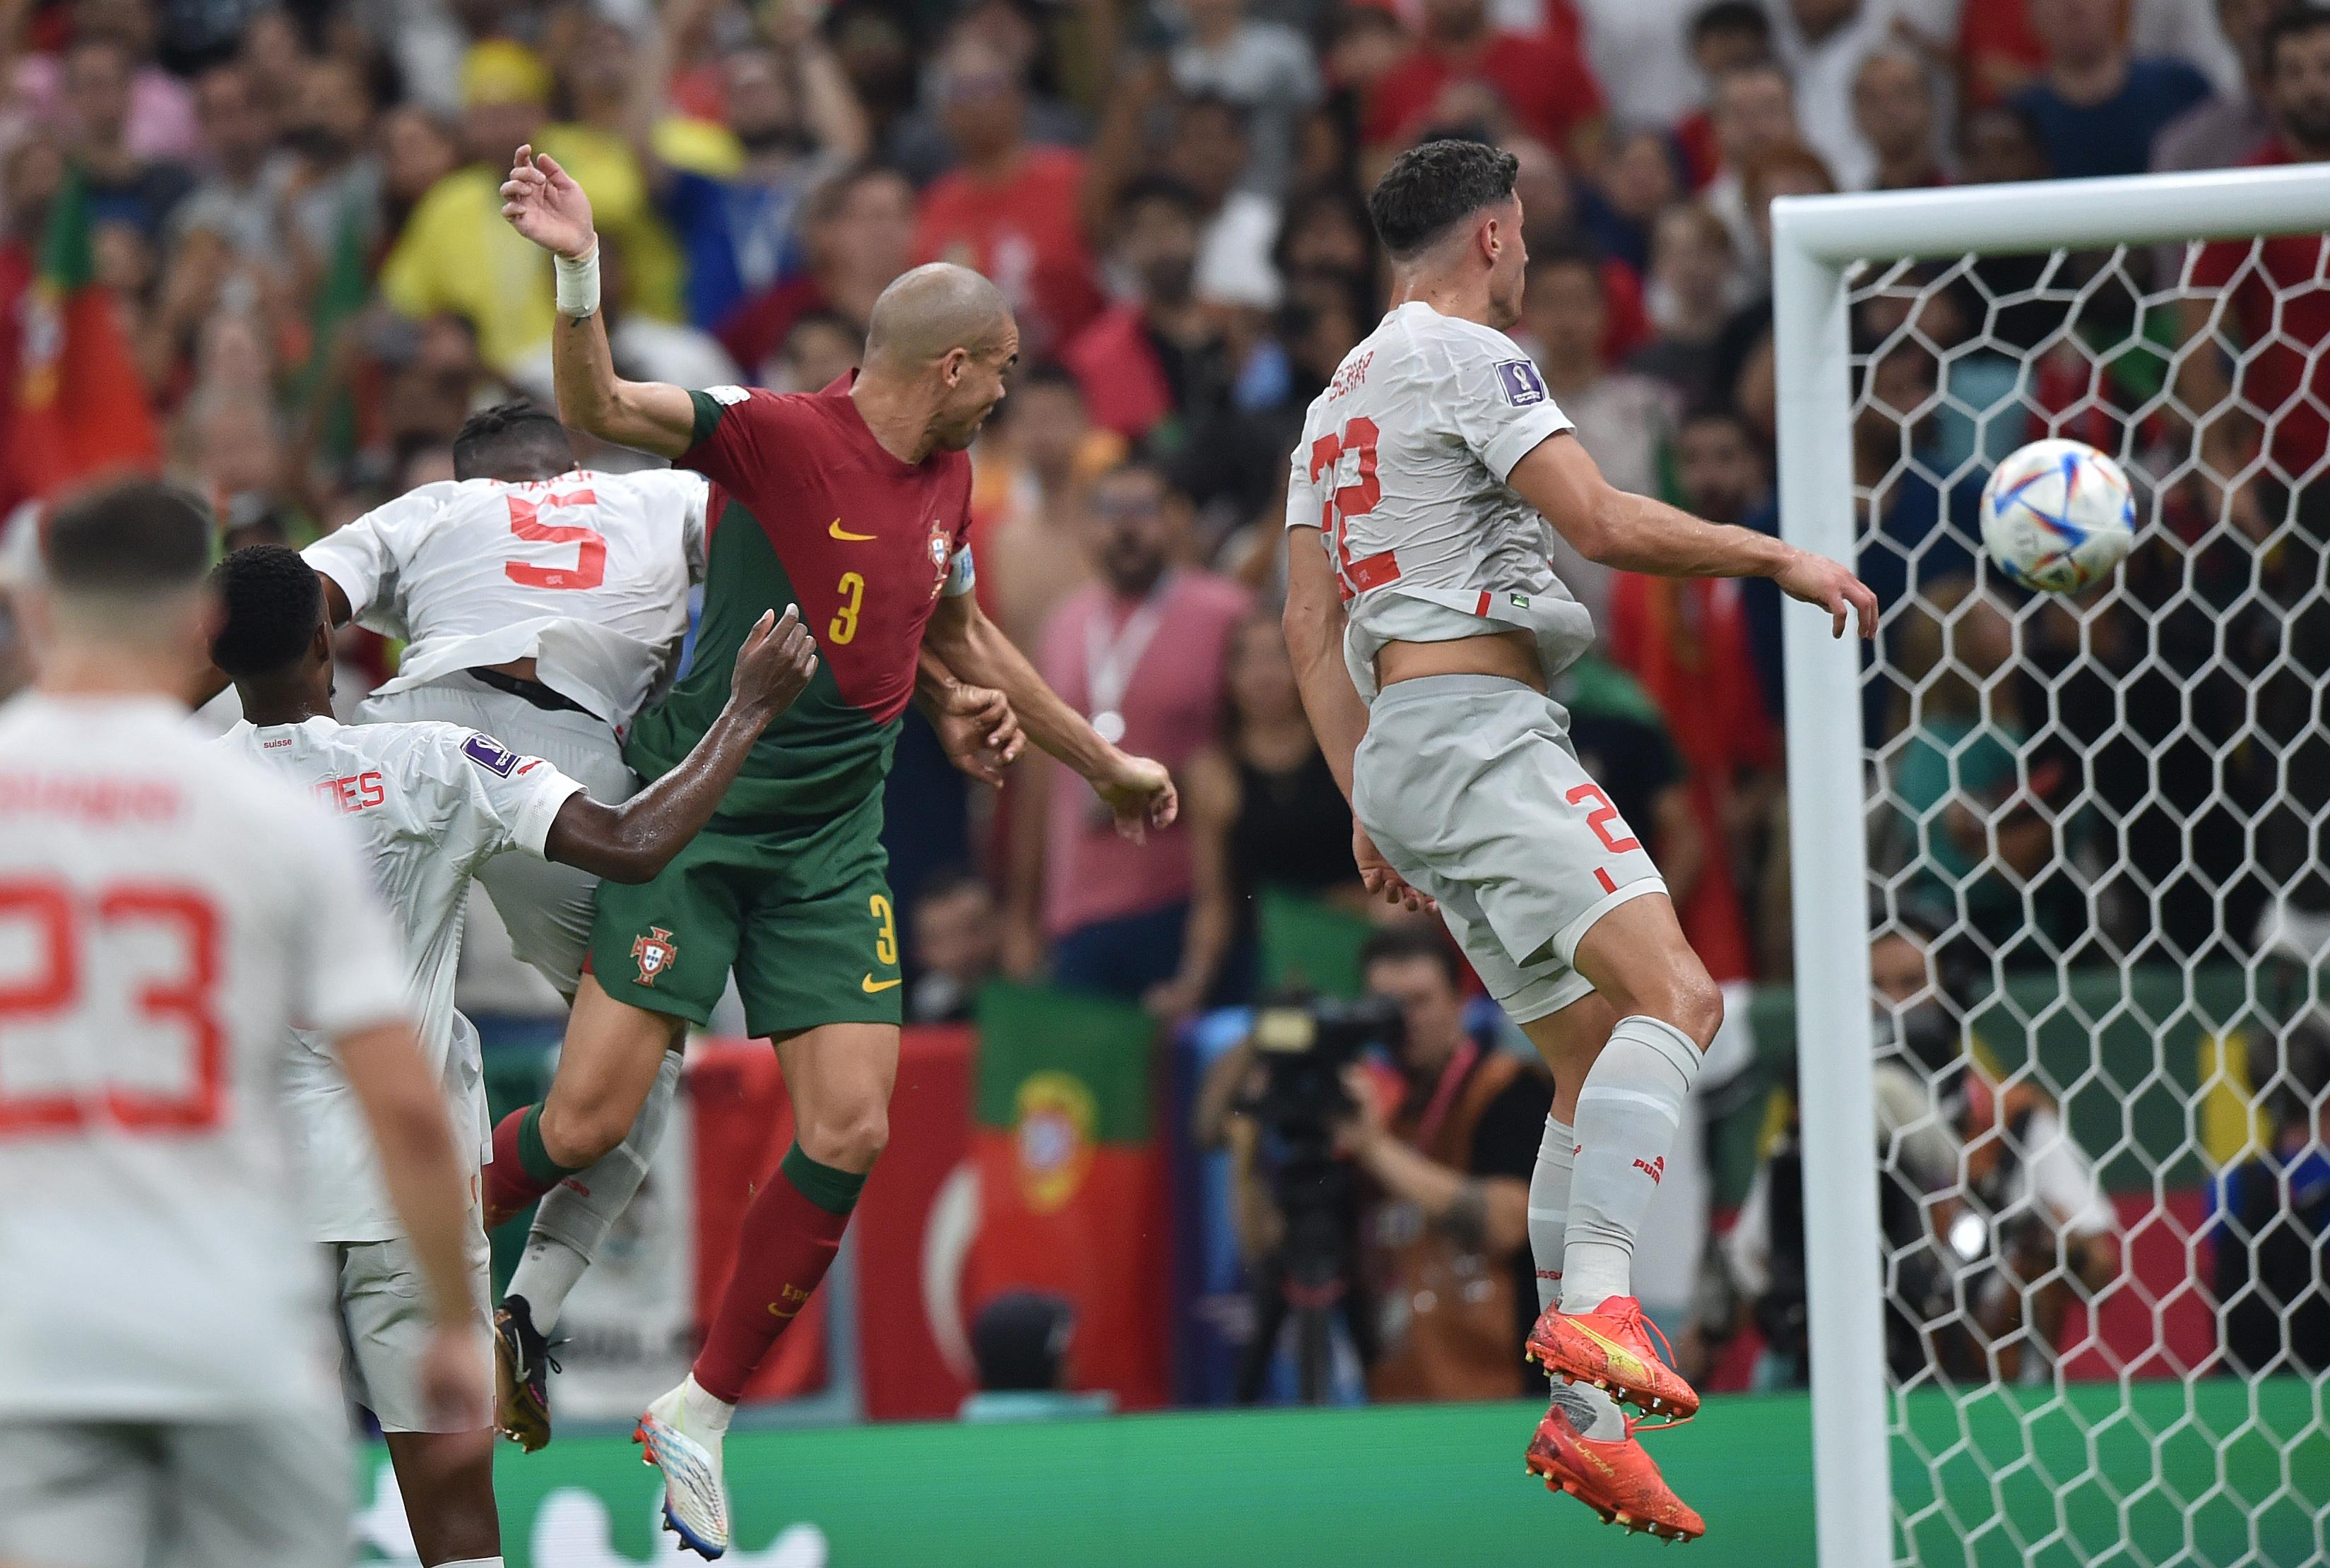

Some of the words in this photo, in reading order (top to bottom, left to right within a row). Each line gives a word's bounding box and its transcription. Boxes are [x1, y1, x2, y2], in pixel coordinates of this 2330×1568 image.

[505, 489, 607, 590] 5
[1310, 416, 1402, 602] 22
[829, 571, 865, 645] 3
[264, 738, 292, 749] suisse
[309, 771, 386, 814] DES
[1565, 783, 1642, 854] 2
[869, 893, 897, 966] 3
[0, 883, 230, 1139] 23
